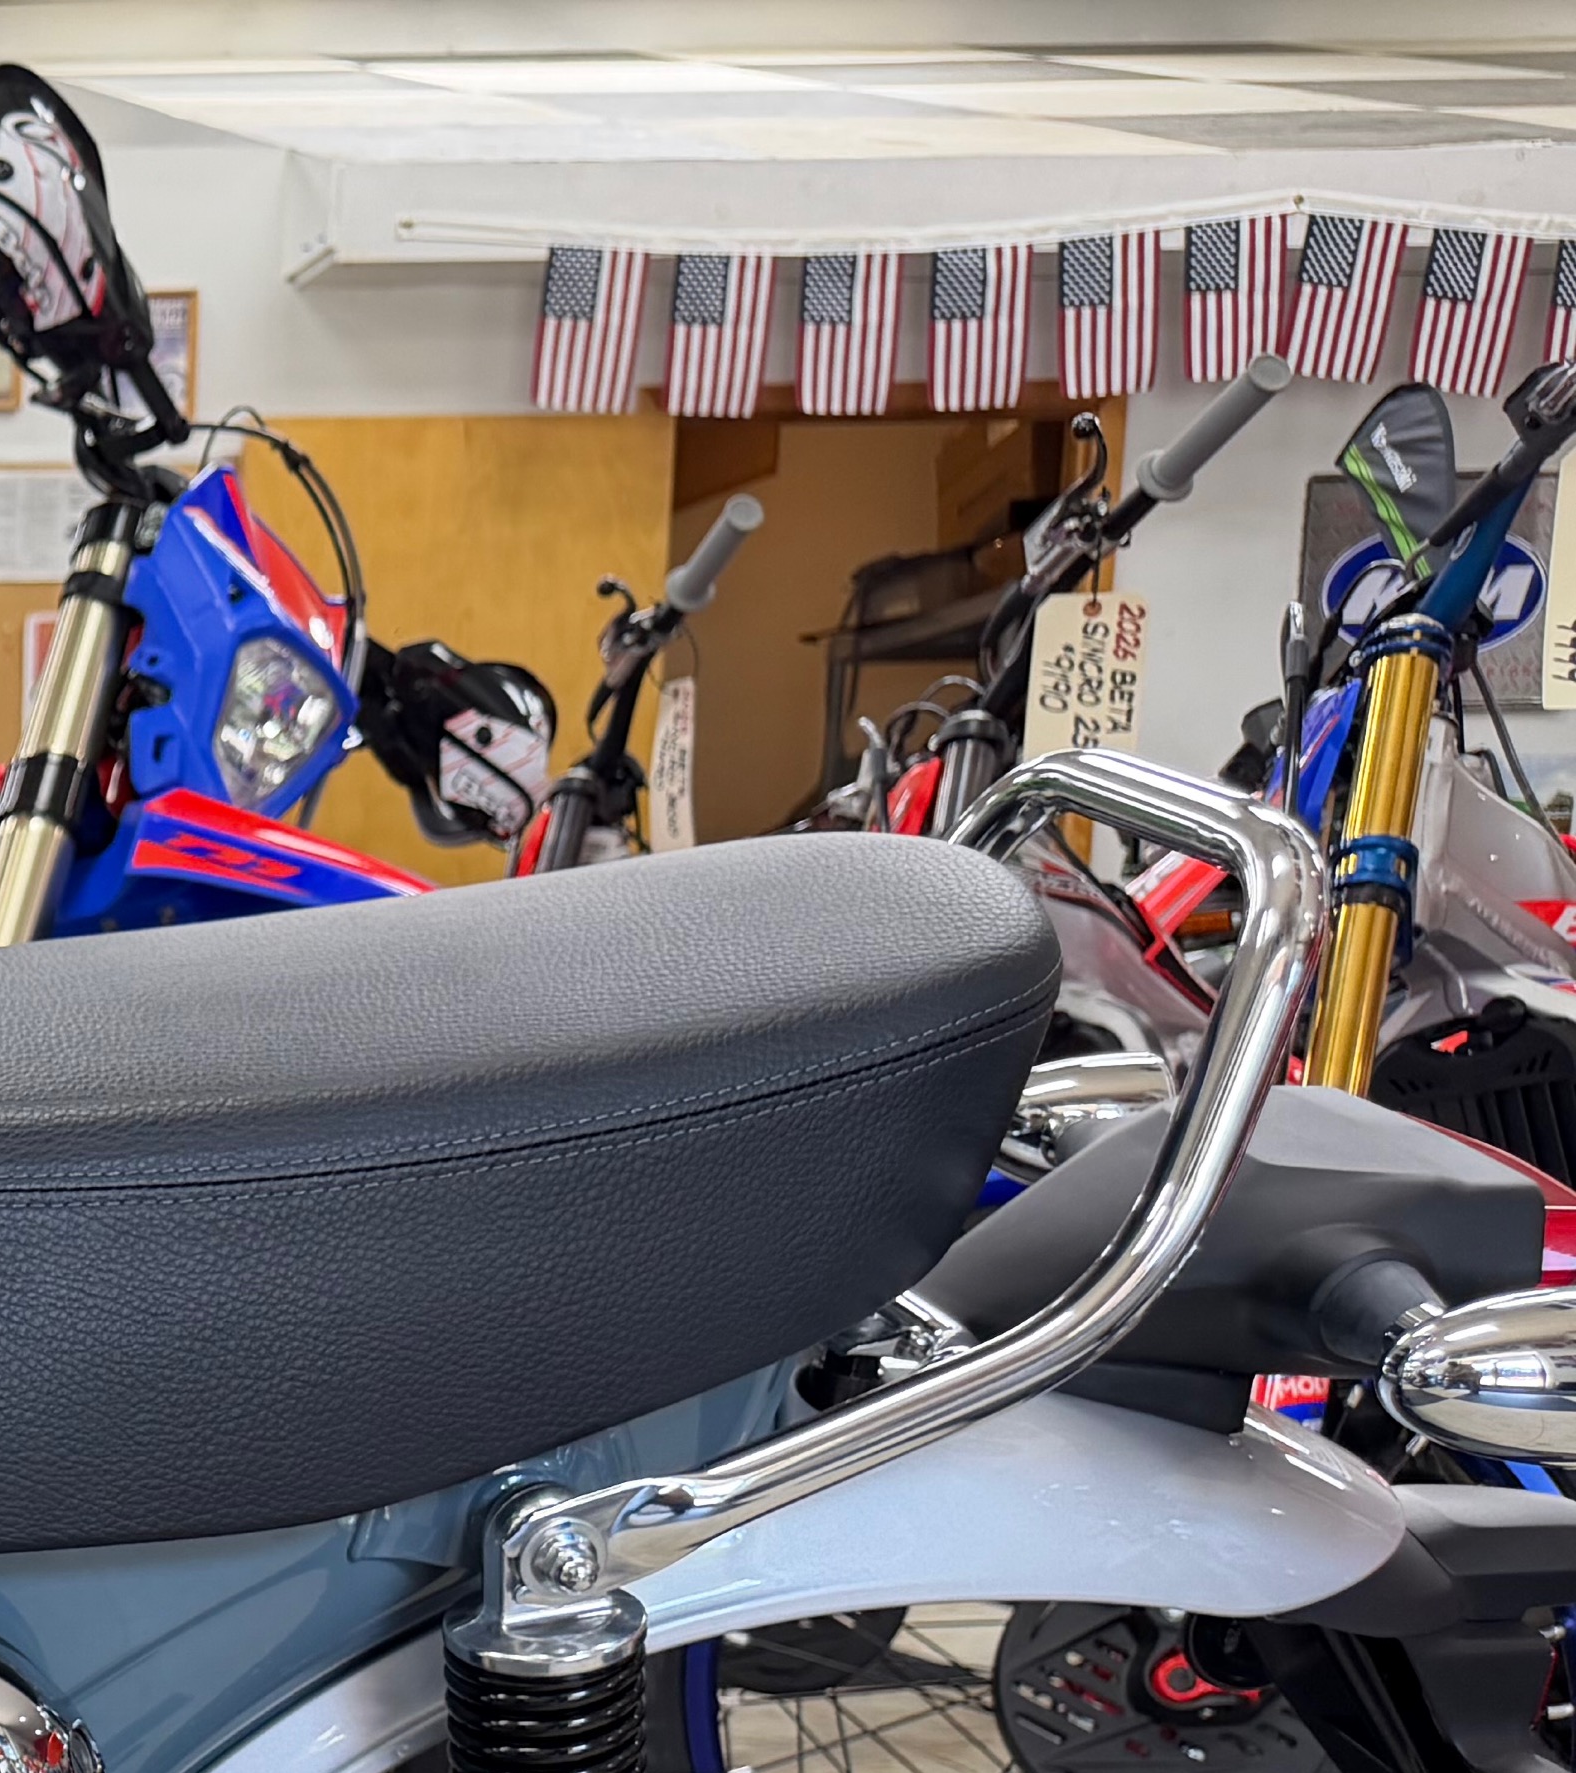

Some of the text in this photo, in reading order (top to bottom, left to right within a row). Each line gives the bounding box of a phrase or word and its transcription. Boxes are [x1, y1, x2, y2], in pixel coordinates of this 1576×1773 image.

[1077, 621, 1110, 707] SINCRO
[1106, 601, 1146, 734] 2026 BETA
